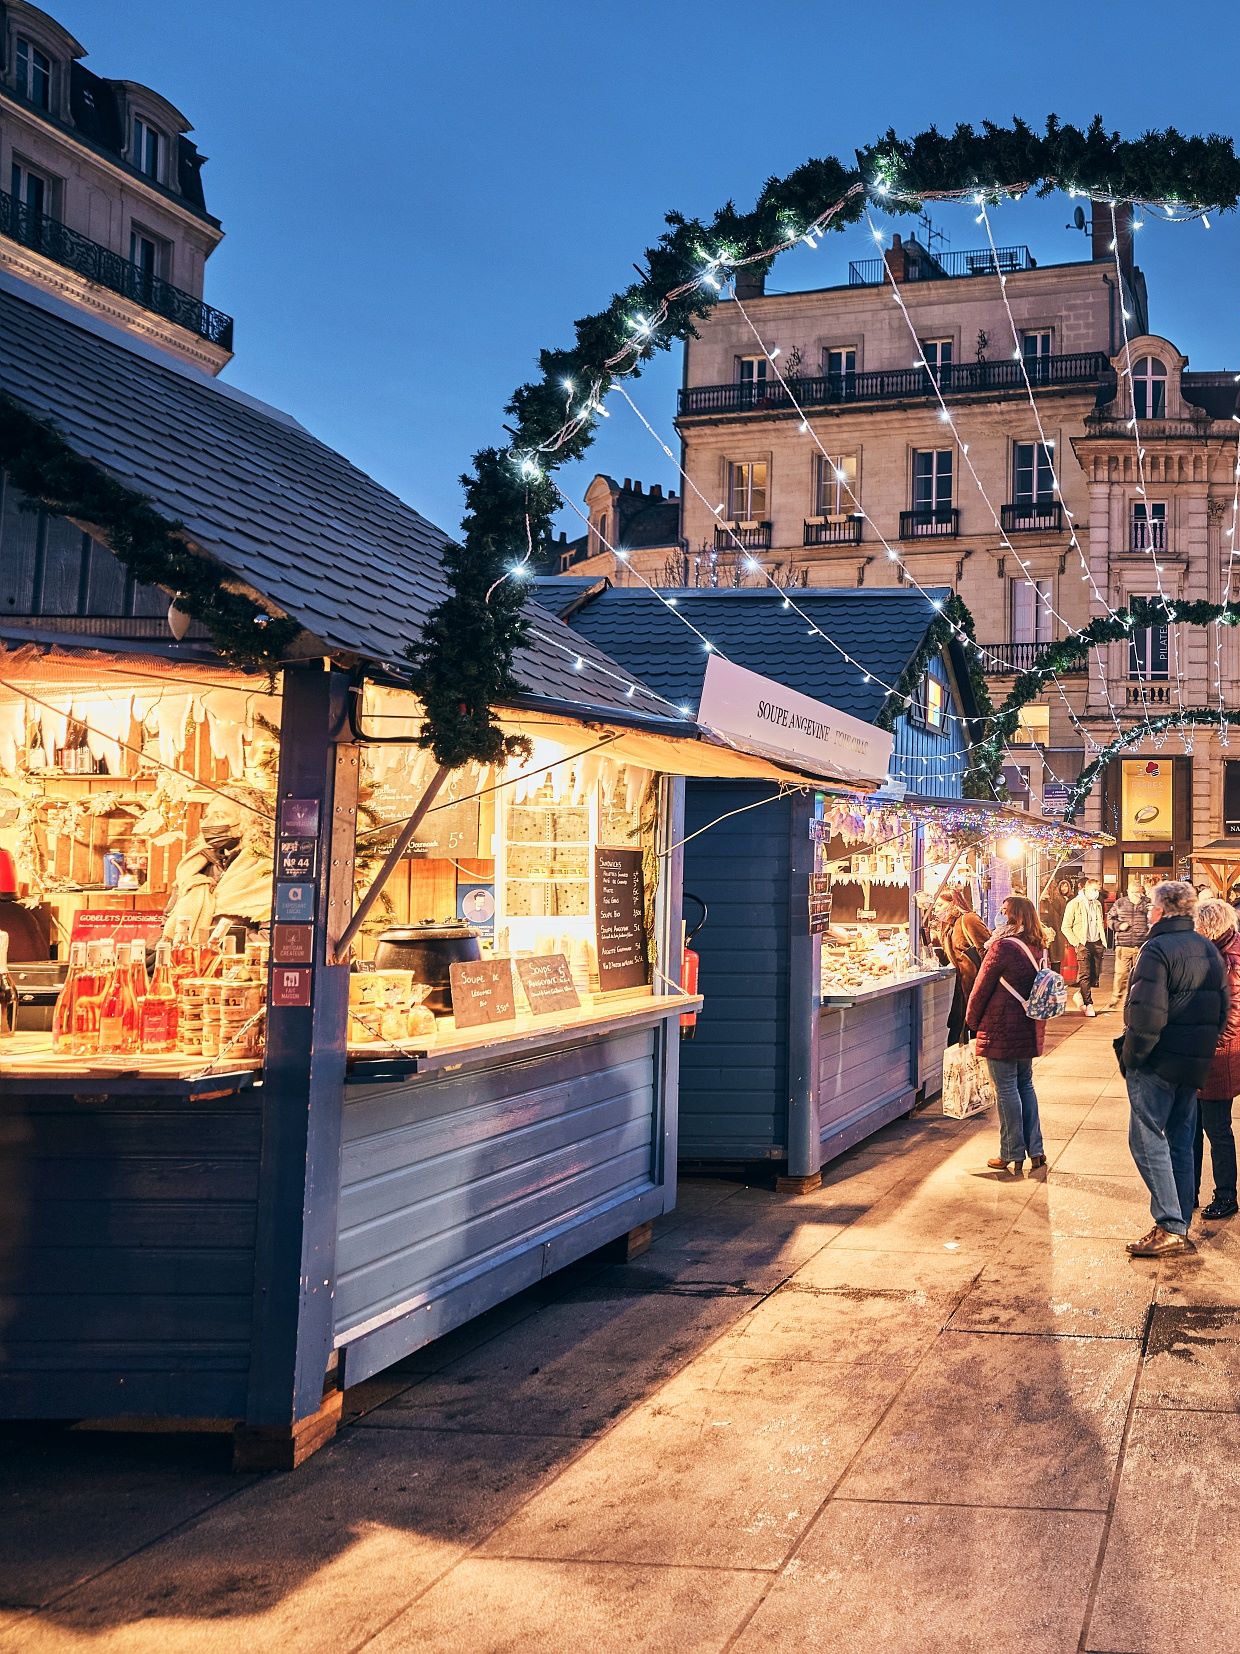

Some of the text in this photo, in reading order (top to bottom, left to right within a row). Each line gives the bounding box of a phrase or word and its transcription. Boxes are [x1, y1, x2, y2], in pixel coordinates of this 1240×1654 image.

[1160, 624, 1168, 660] PILATES
[757, 700, 789, 727] SOUPE
[788, 713, 831, 742] ANGEVINE
[297, 858, 310, 867] 44
[79, 914, 121, 922] GOBELETS
